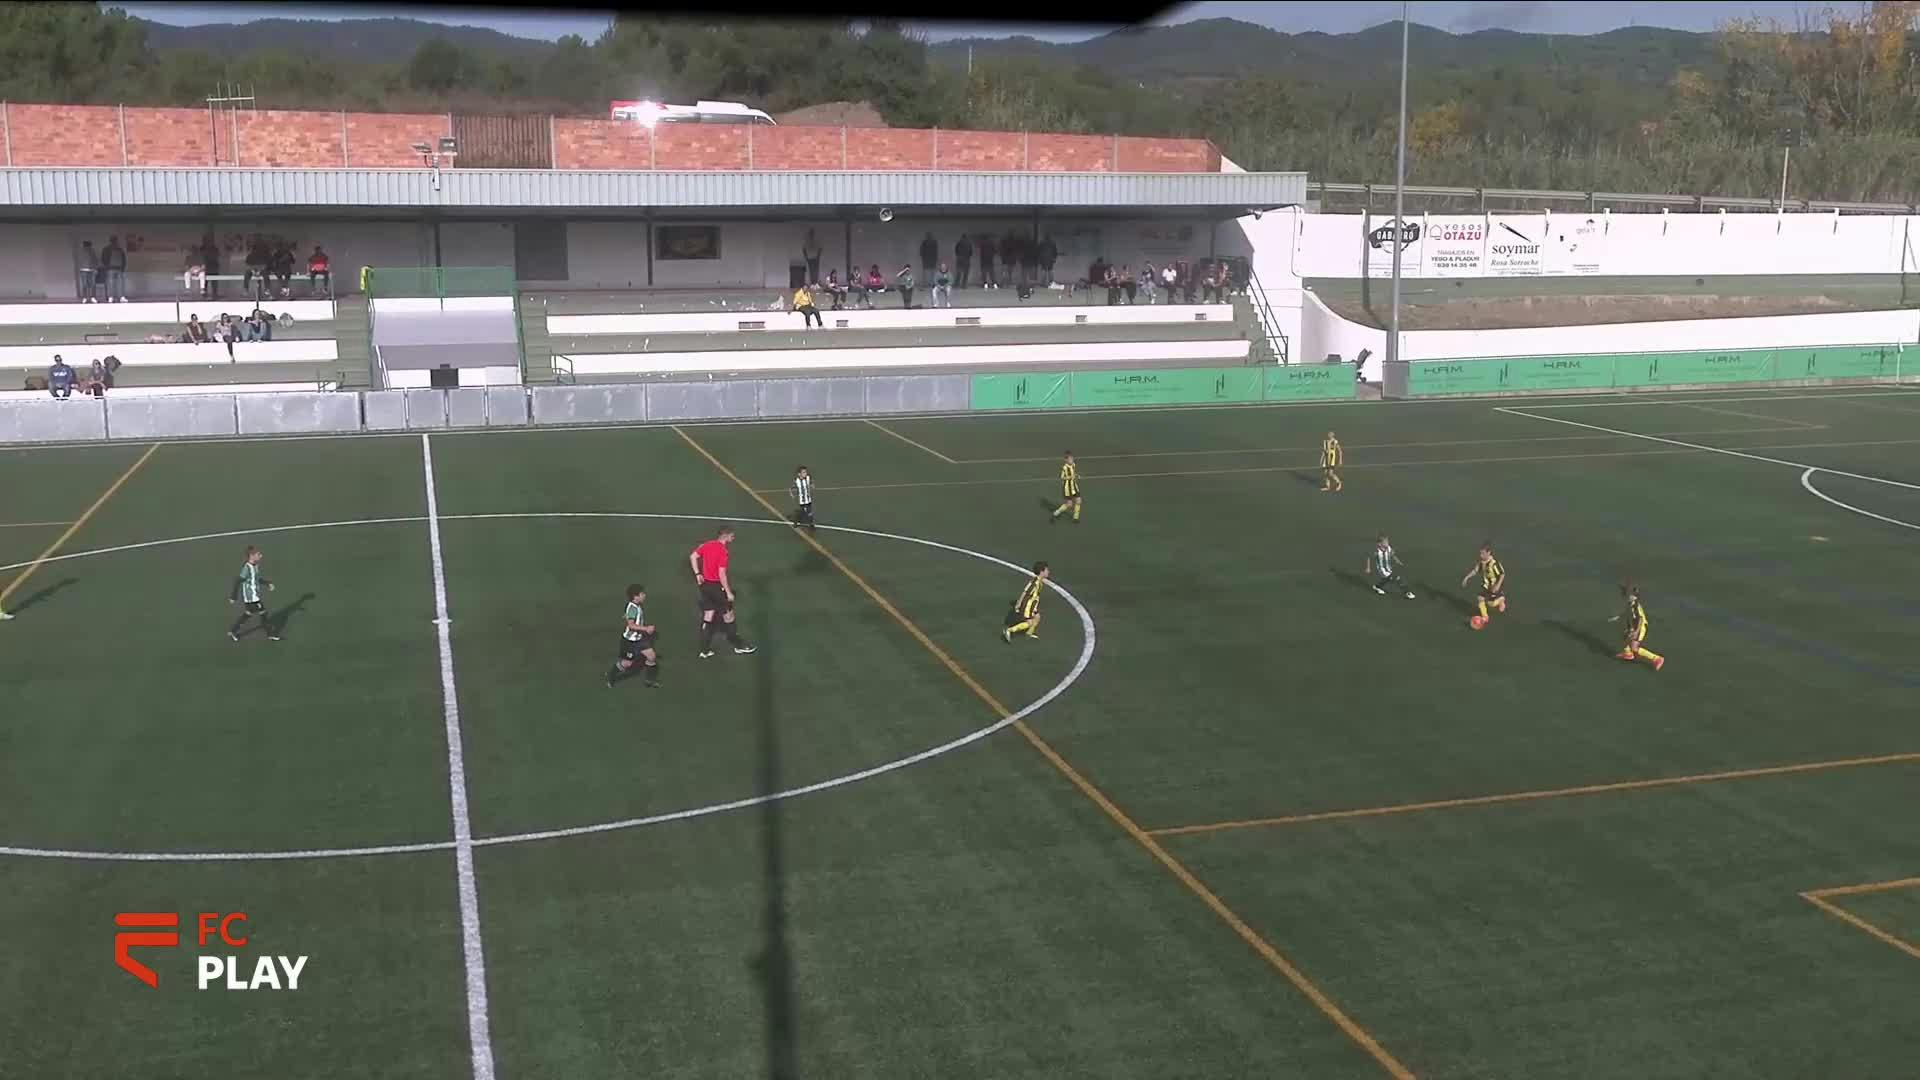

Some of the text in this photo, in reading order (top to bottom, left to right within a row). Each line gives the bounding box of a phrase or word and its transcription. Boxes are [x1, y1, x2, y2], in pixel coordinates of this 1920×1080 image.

[1376, 231, 1414, 240] GABRO
[1444, 231, 1481, 240] OTAZU
[1492, 245, 1541, 258] soymar
